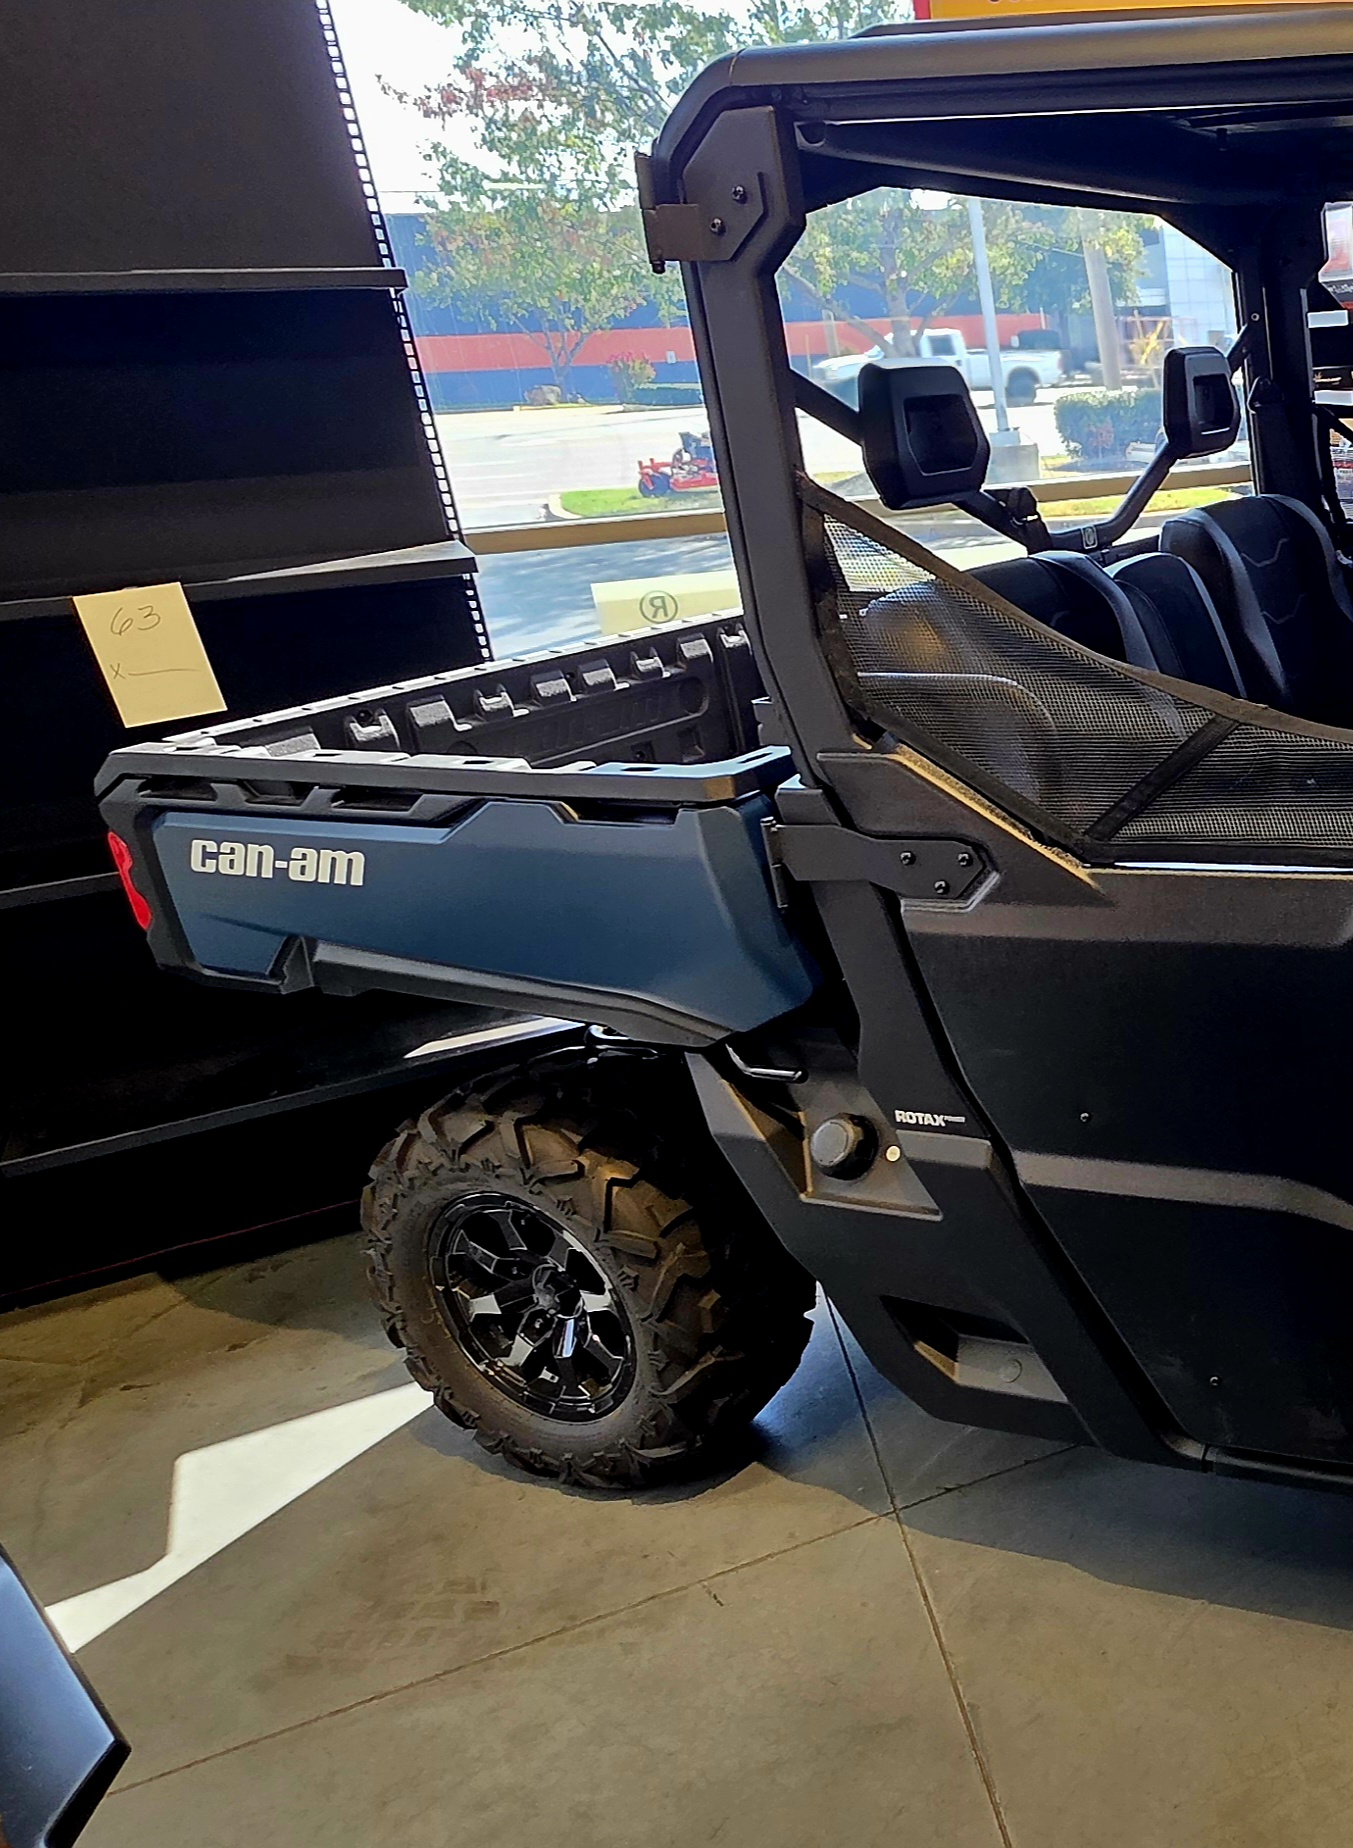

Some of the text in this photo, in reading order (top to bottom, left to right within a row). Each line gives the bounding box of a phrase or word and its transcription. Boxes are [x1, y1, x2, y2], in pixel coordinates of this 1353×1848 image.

[110, 605, 162, 637] 63
[190, 838, 366, 887] can-am
[894, 1109, 946, 1127] ROTAX
